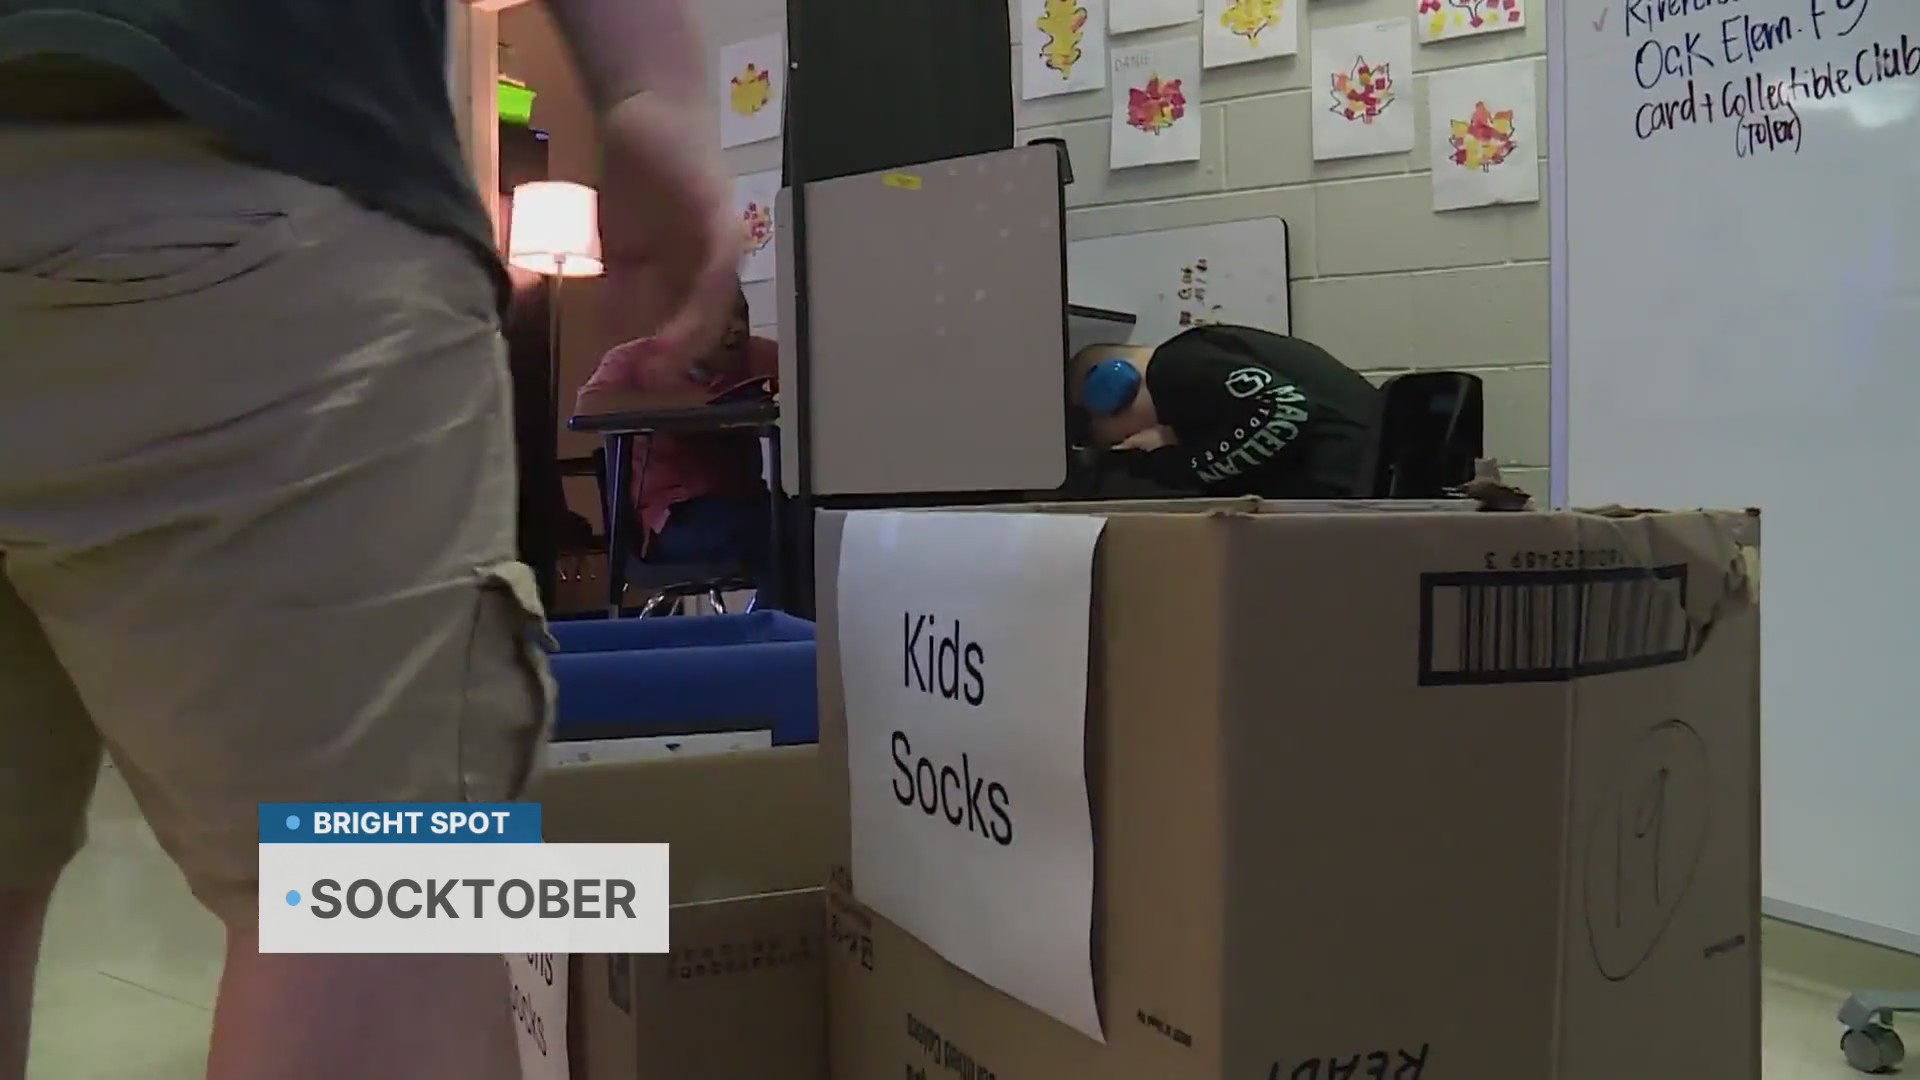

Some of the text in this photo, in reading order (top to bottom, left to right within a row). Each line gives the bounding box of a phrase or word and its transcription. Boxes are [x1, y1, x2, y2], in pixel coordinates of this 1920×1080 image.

[1197, 385, 1309, 484] MAGELLAN
[904, 611, 985, 706] Kids
[891, 730, 1013, 846] Socks
